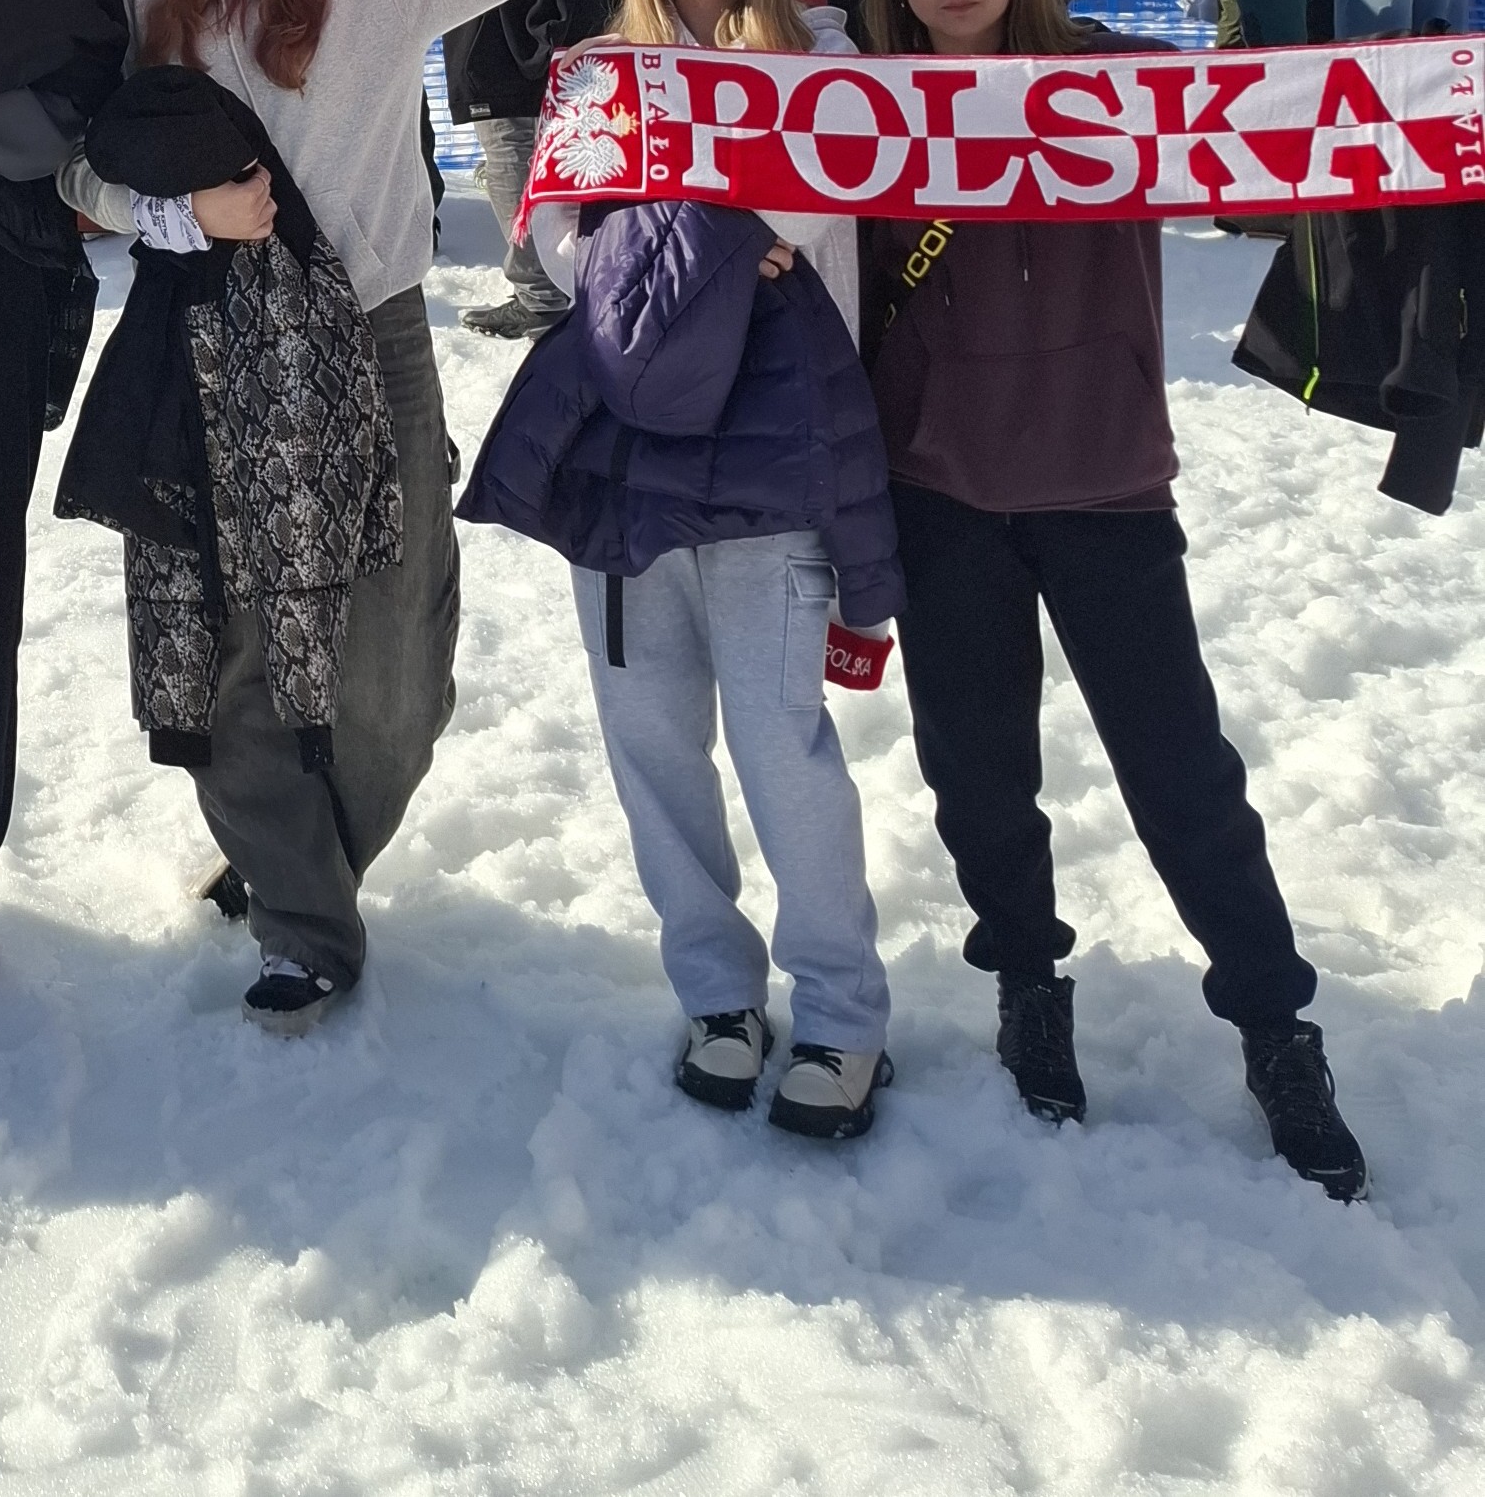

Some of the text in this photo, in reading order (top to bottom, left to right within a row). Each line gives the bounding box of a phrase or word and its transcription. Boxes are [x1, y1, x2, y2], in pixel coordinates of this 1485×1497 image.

[641, 52, 670, 181] BIAŁO
[676, 57, 1446, 206] POLSKA
[1451, 49, 1485, 186] BIAŁO
